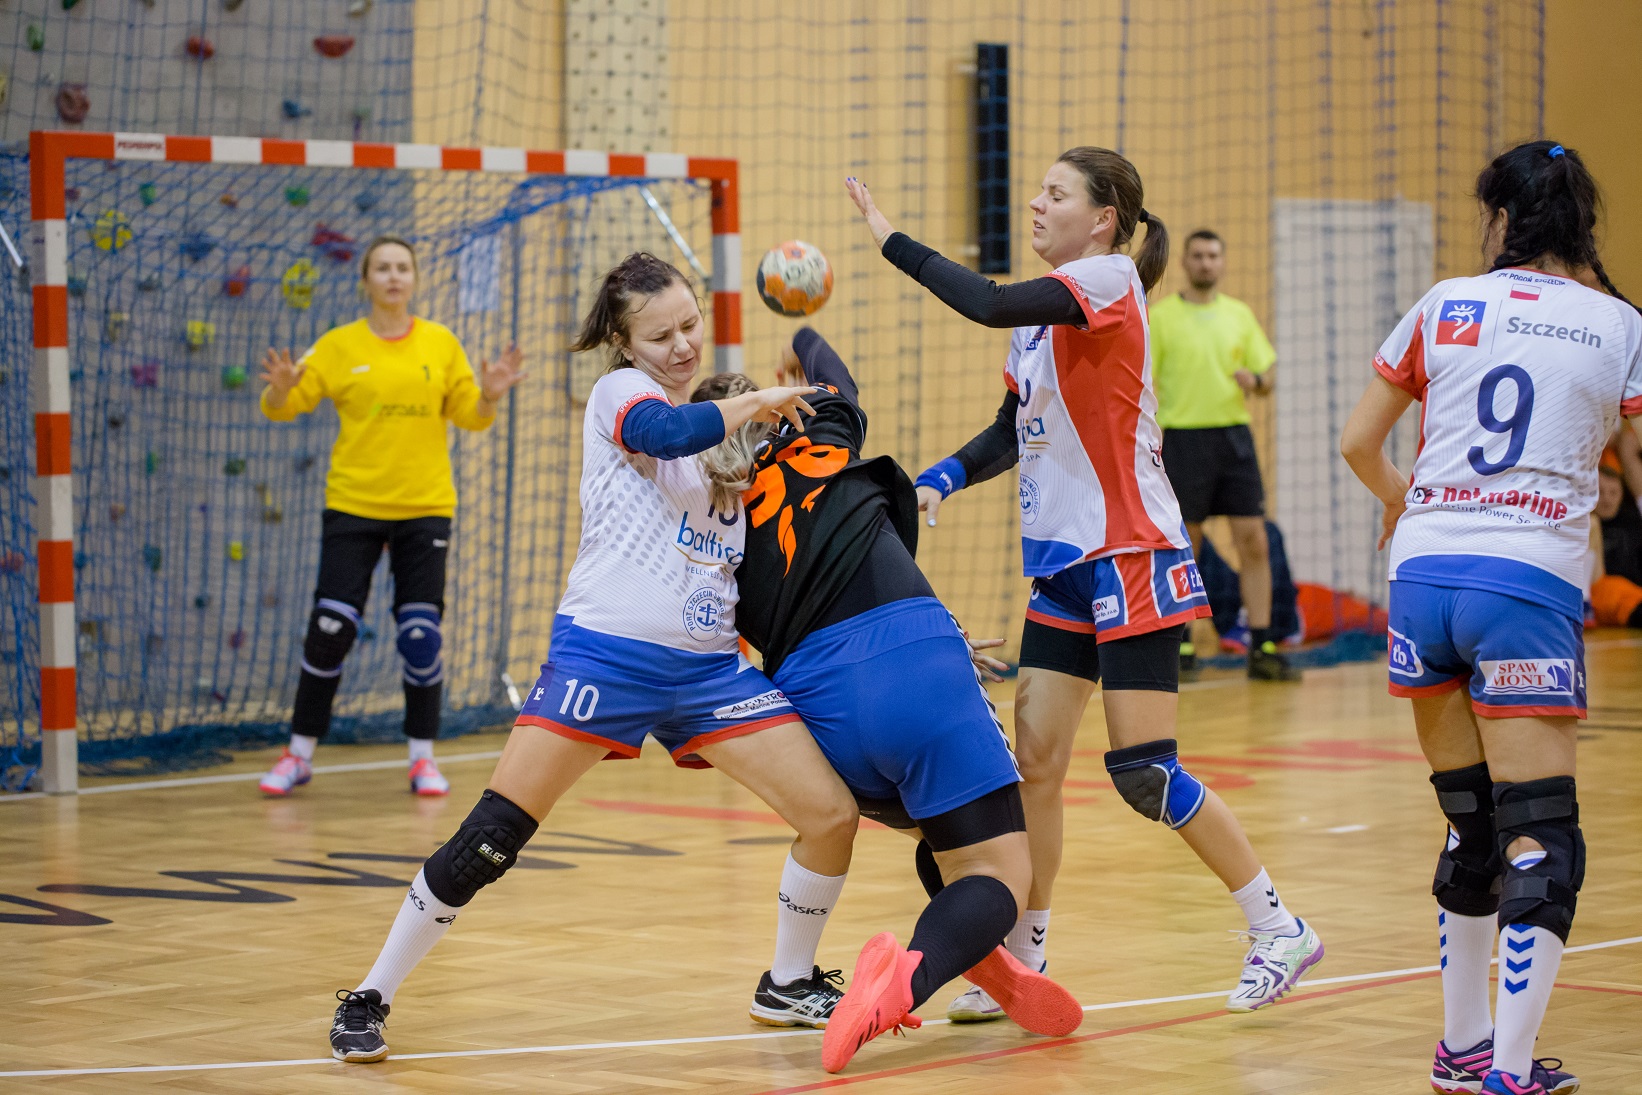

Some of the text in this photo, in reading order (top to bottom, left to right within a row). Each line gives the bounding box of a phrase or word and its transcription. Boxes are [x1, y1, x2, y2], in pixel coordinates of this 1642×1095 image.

[1507, 316, 1602, 349] Szczecin
[1467, 364, 1535, 476] 9
[1479, 505, 1515, 521] Power
[1498, 662, 1540, 674] SPAW
[1493, 674, 1547, 687] MONT
[559, 678, 600, 722] 10
[480, 843, 507, 863] SELECT
[408, 886, 427, 911] sics
[786, 902, 829, 916] asics
